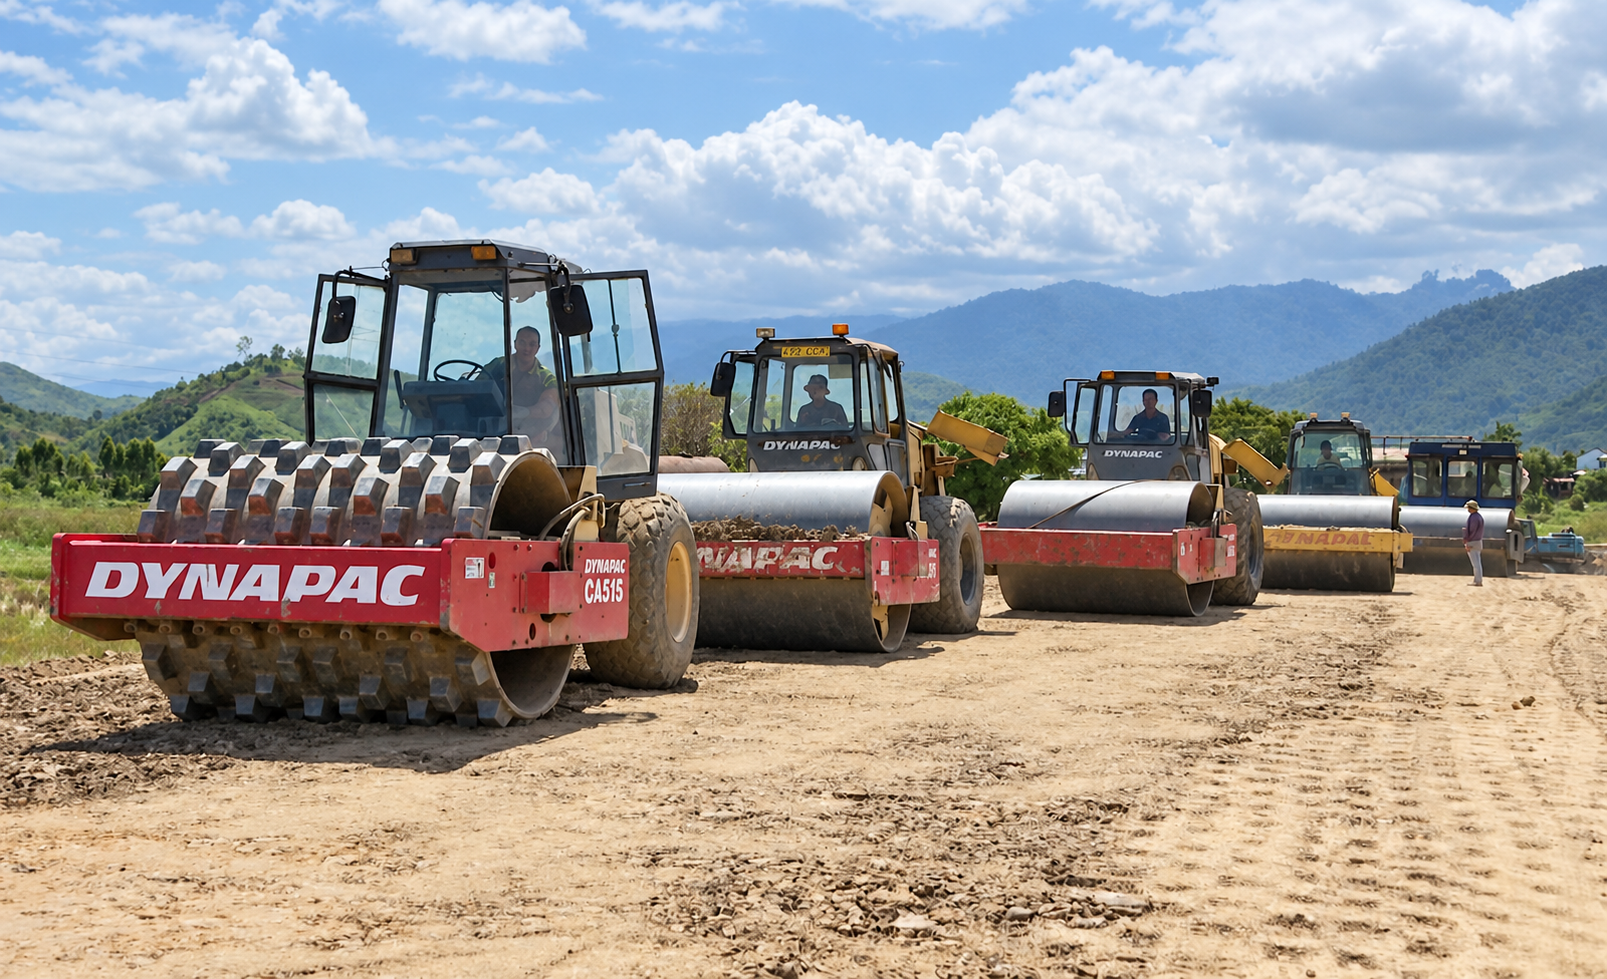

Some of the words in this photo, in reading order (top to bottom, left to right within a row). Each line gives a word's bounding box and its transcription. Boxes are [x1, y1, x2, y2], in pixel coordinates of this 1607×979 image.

[1104, 449, 1163, 459] DYNAPAC
[584, 558, 626, 574] DYNAPAC
[84, 561, 426, 606] DYNAPAC
[584, 578, 624, 604] CA515
